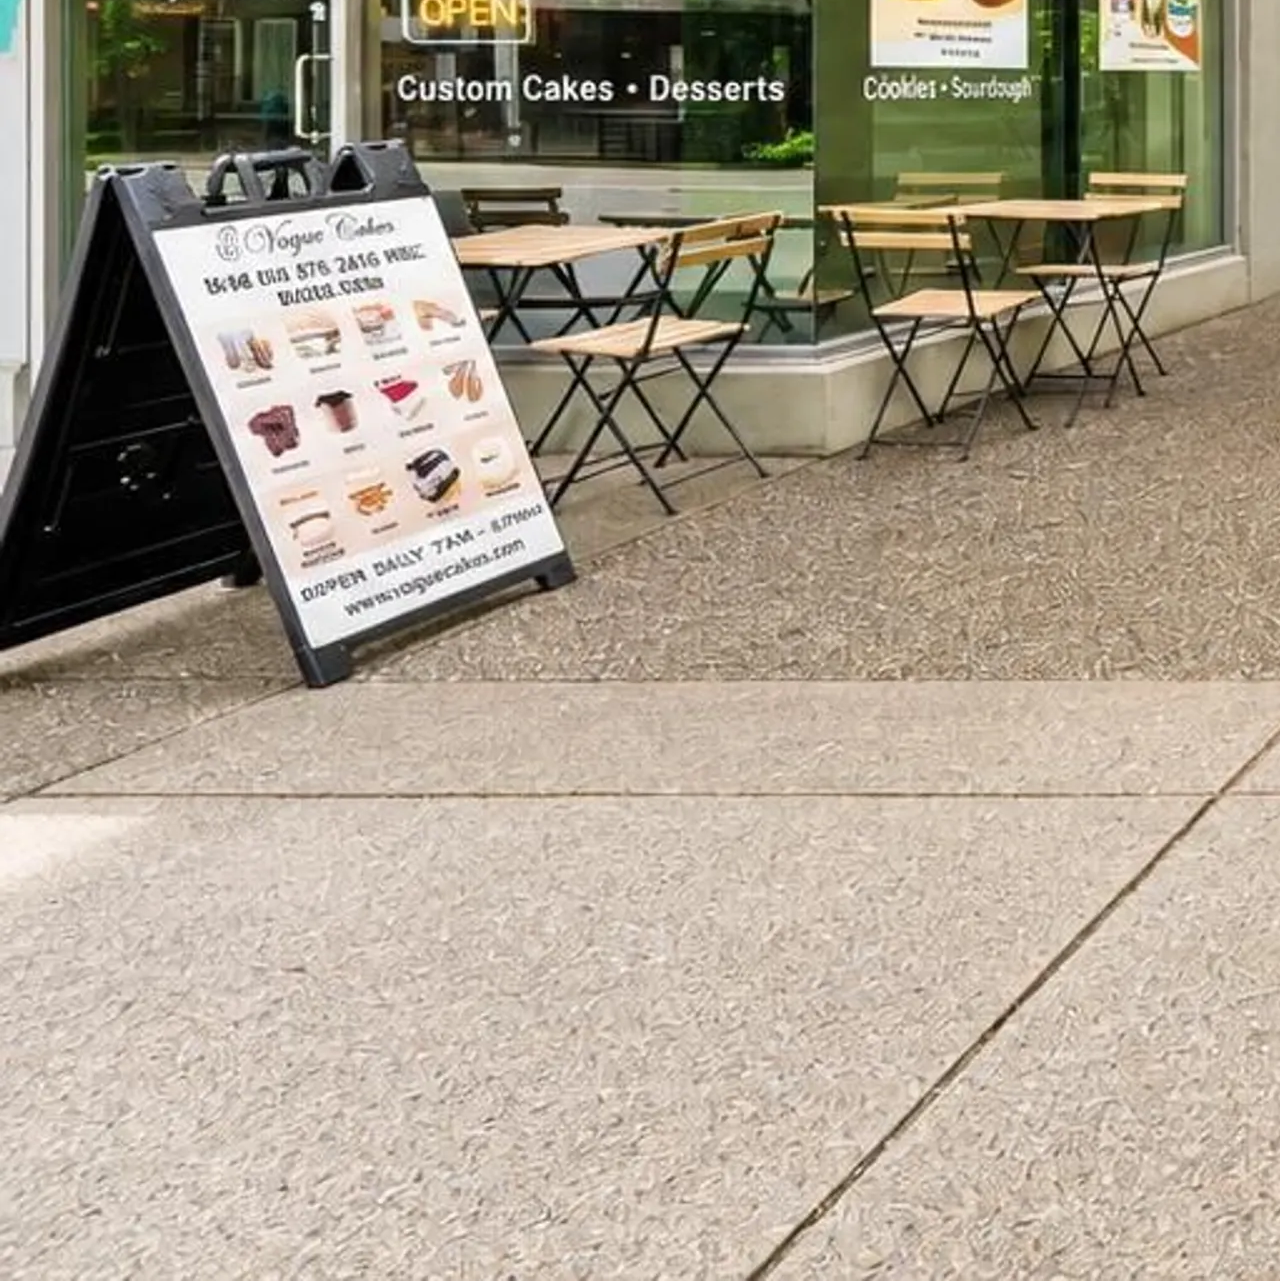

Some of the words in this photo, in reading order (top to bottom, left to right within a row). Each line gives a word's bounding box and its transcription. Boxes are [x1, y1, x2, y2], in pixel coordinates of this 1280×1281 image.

[398, 74, 512, 103] Custom
[522, 74, 615, 103] Cakes
[650, 74, 786, 103] Desserts
[863, 73, 937, 100] Cookies
[951, 74, 1032, 104] Sourdough
[243, 220, 325, 258] Vogue
